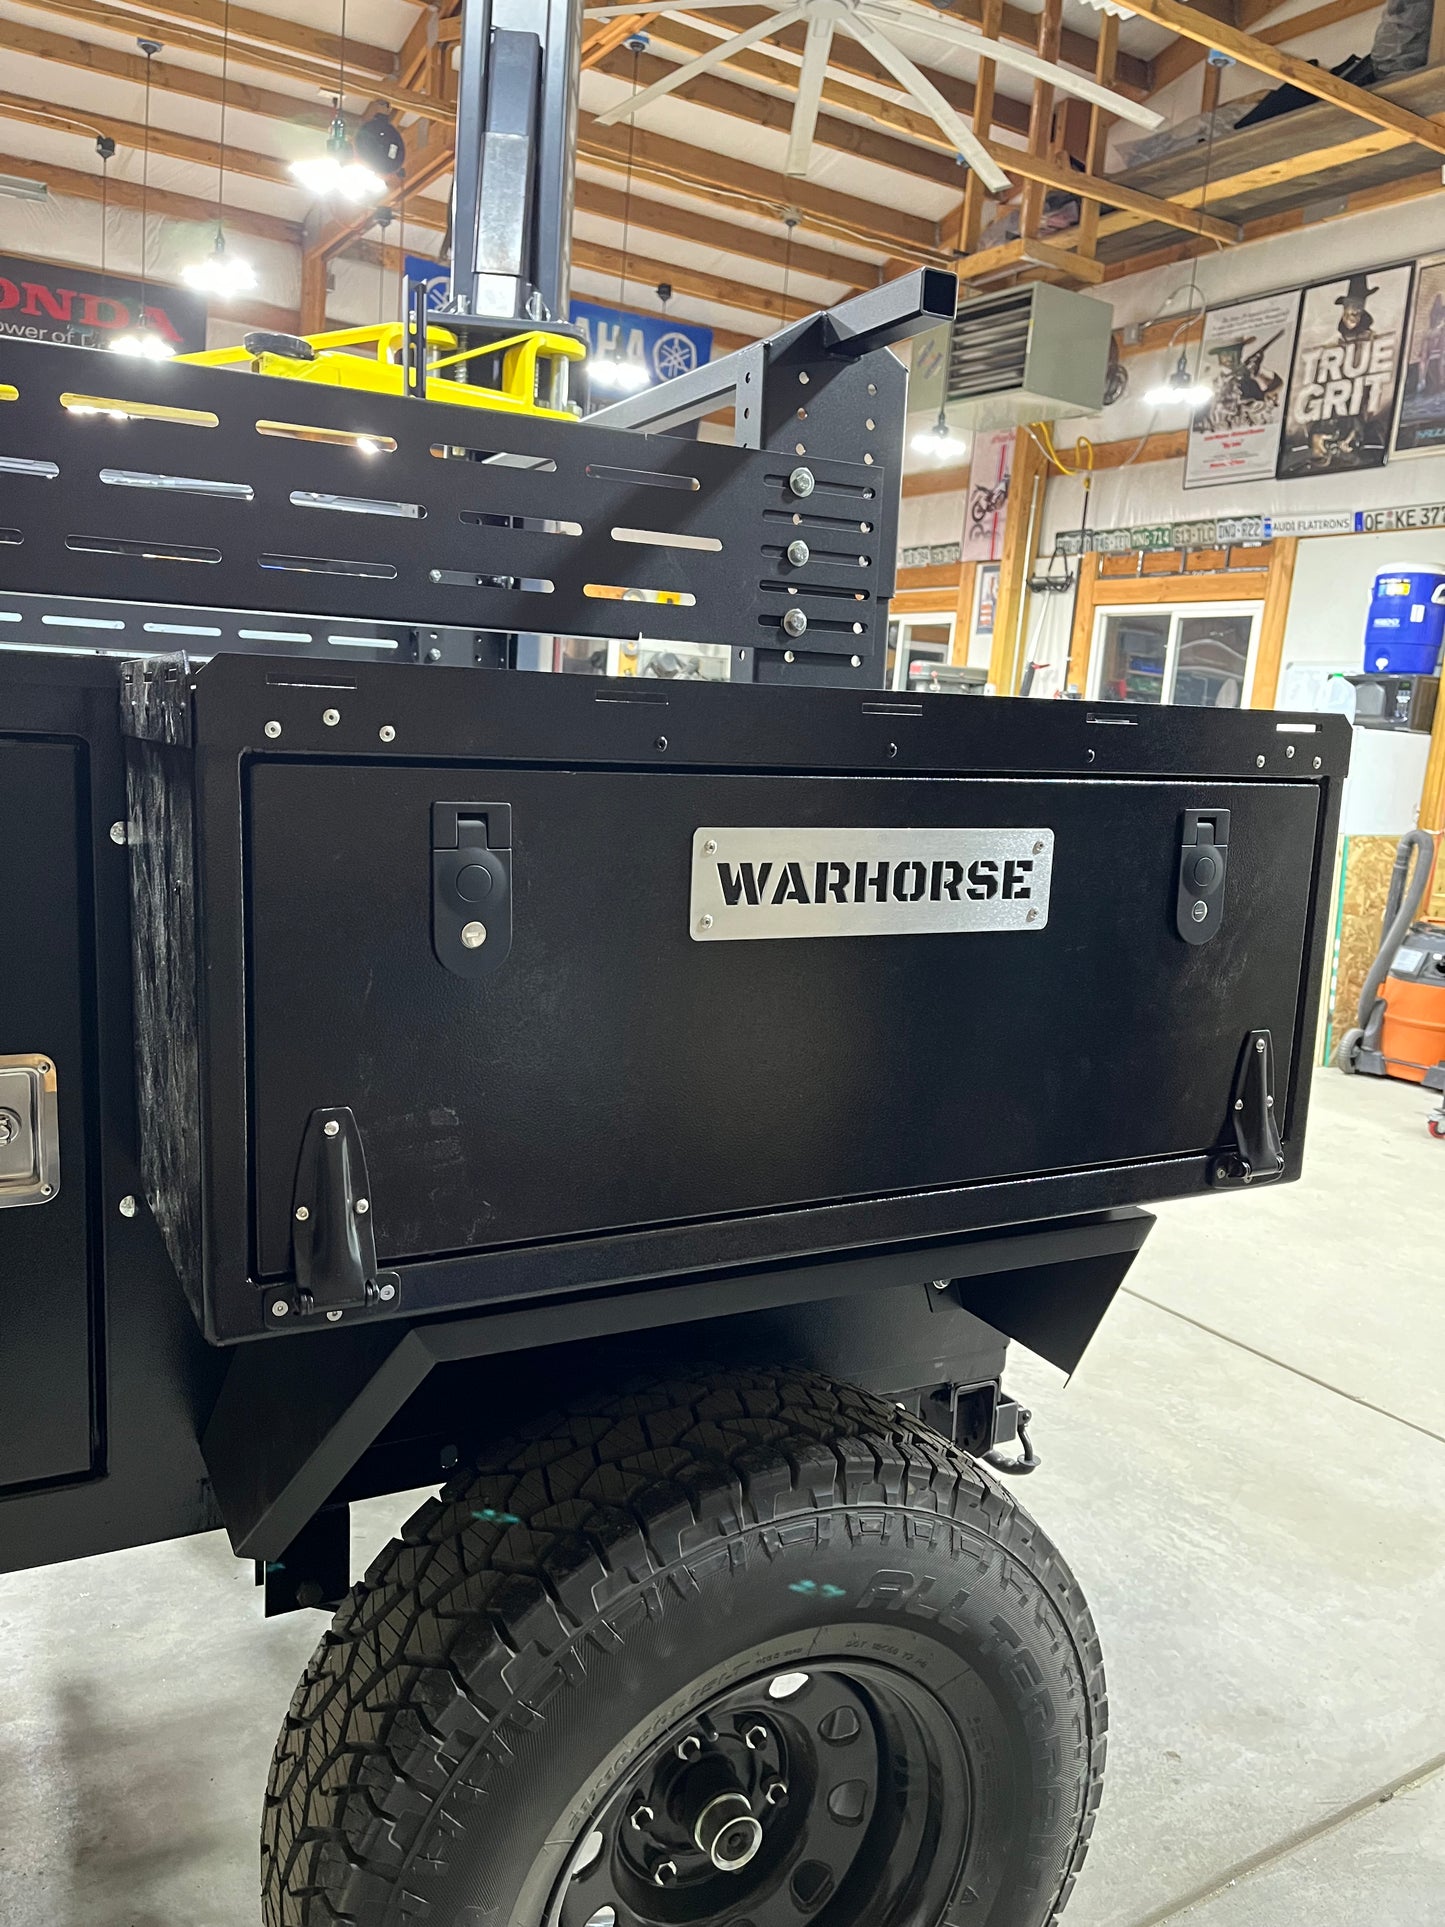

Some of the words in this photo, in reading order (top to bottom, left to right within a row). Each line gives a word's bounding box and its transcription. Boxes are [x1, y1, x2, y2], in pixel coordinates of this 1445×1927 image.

[51, 325, 75, 344] of
[1302, 336, 1396, 385] TRUE
[1294, 372, 1392, 425] GRIT
[1273, 520, 1296, 532] AUDI
[1297, 518, 1351, 531] FLATIRONS
[1395, 509, 1417, 527] KE
[716, 859, 1035, 906] WARHORSE
[855, 1568, 972, 1634] ALL
